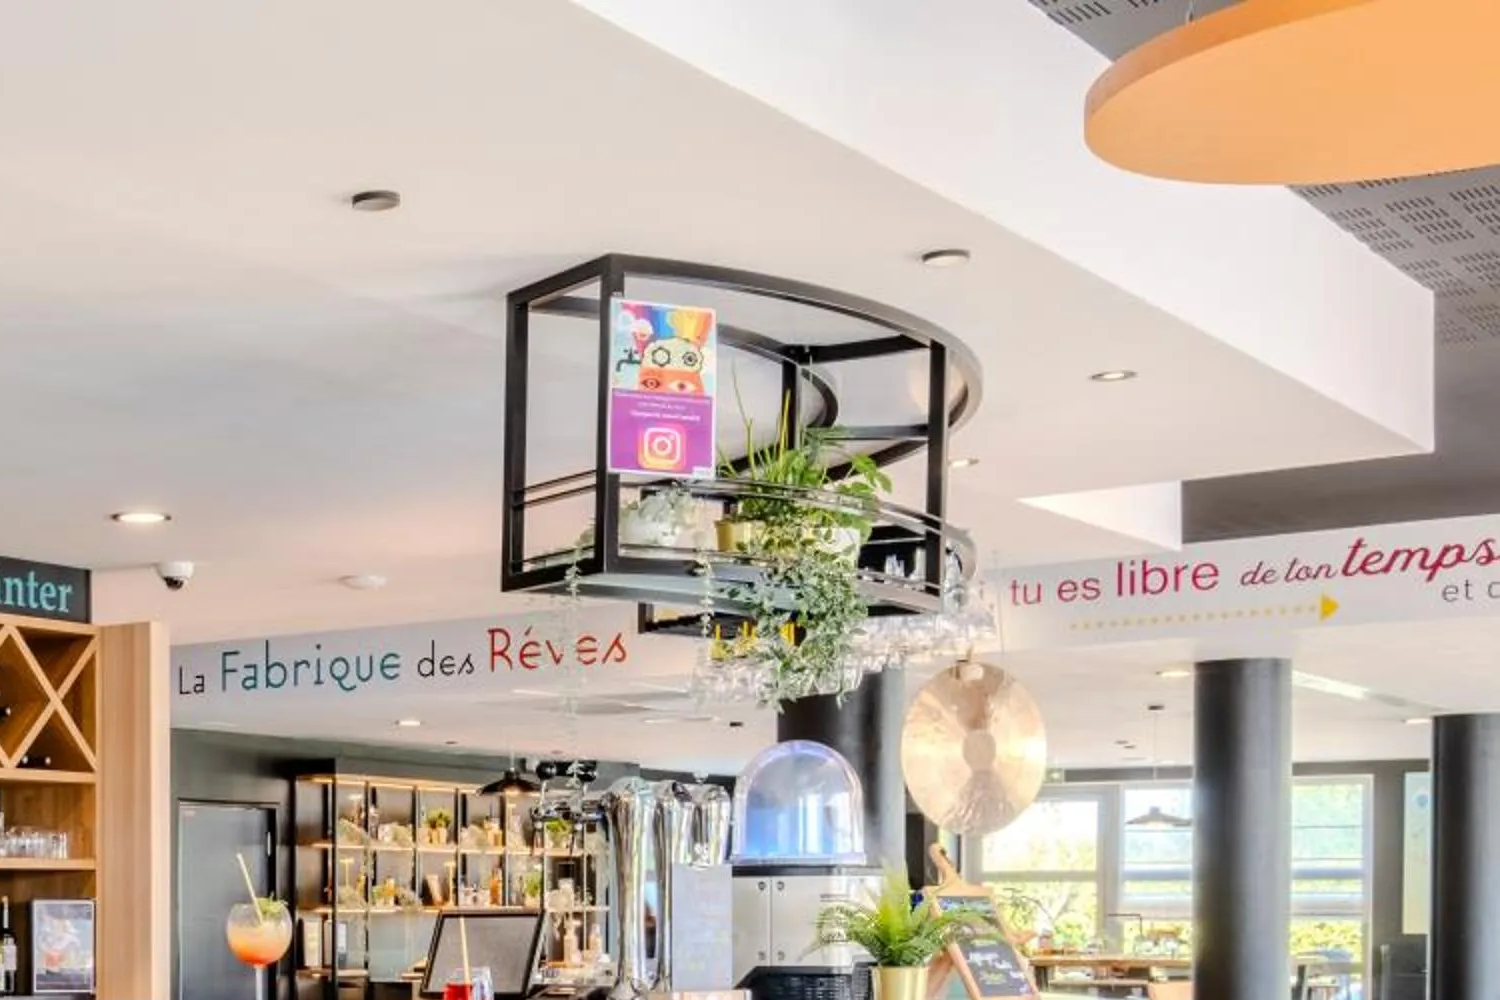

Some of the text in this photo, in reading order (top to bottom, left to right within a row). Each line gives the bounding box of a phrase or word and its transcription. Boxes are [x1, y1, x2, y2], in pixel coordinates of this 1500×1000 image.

[1010, 579, 1043, 606] tu
[1057, 575, 1102, 602] es
[1116, 560, 1220, 597] libre
[1240, 561, 1277, 586] de
[1341, 537, 1500, 583] temps
[1441, 579, 1475, 602] et
[178, 666, 206, 695] La
[220, 640, 401, 691] Fabrique
[417, 640, 475, 677] des
